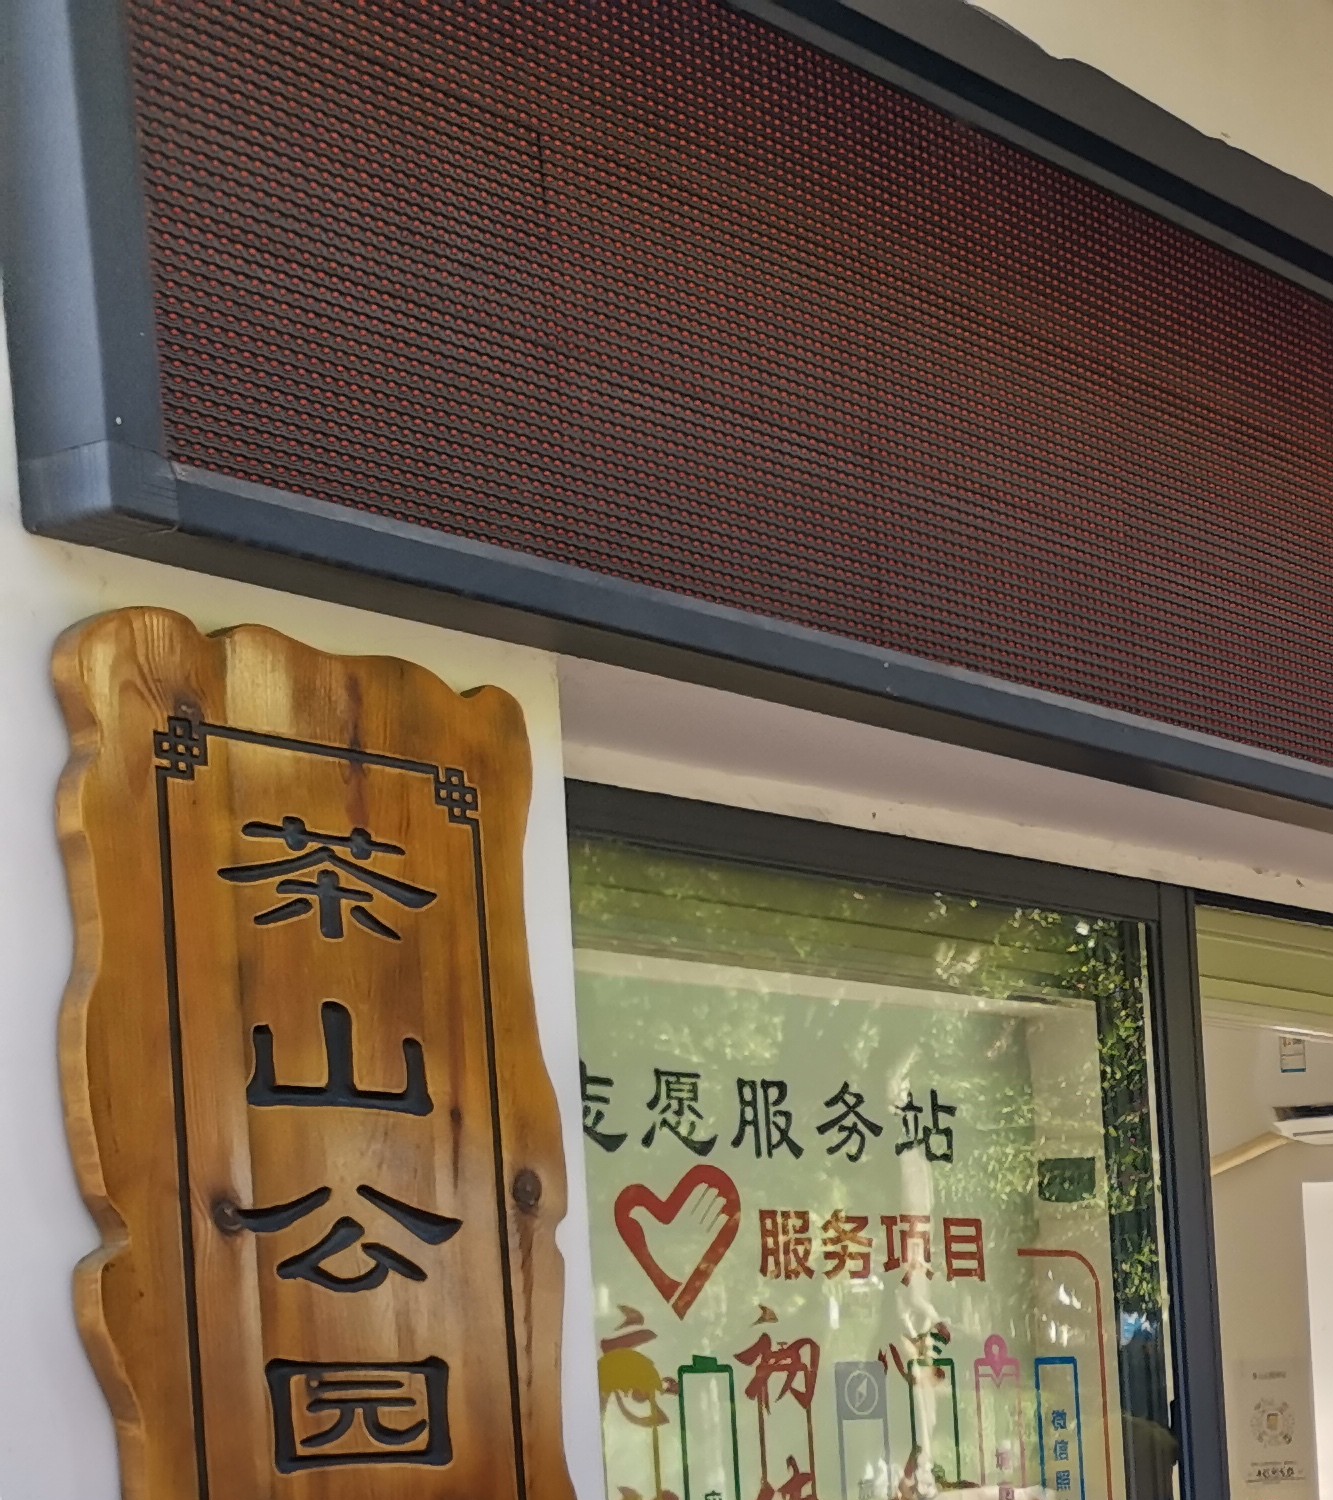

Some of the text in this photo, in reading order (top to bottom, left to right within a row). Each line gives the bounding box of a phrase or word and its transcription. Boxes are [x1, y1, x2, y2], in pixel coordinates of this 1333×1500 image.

[579, 1060, 958, 1164] 志愿服务站
[758, 1208, 987, 1286] 服务项目
